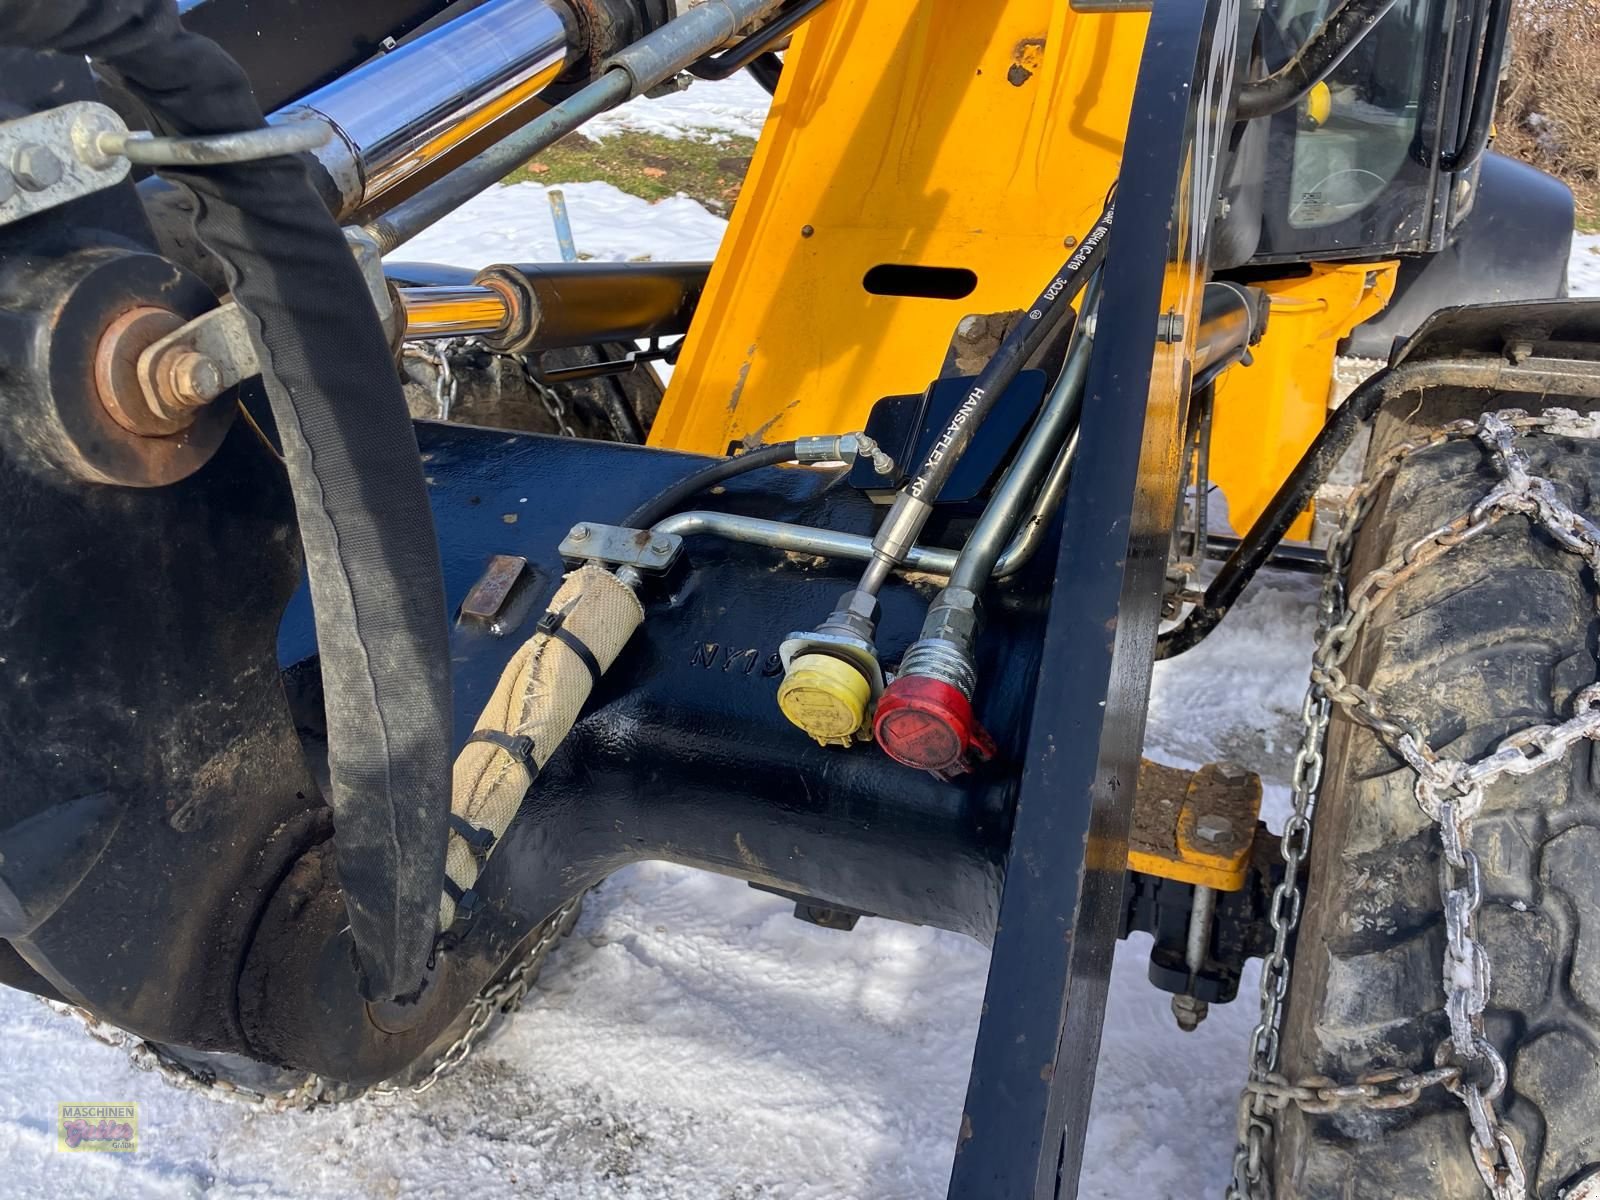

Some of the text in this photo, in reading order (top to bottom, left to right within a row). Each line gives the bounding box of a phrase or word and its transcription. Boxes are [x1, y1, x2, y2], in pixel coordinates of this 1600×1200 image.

[1086, 226, 1108, 247] MSHA
[1043, 277, 1068, 301] 3Q20
[911, 387, 985, 497] HANSA-FLEX KP
